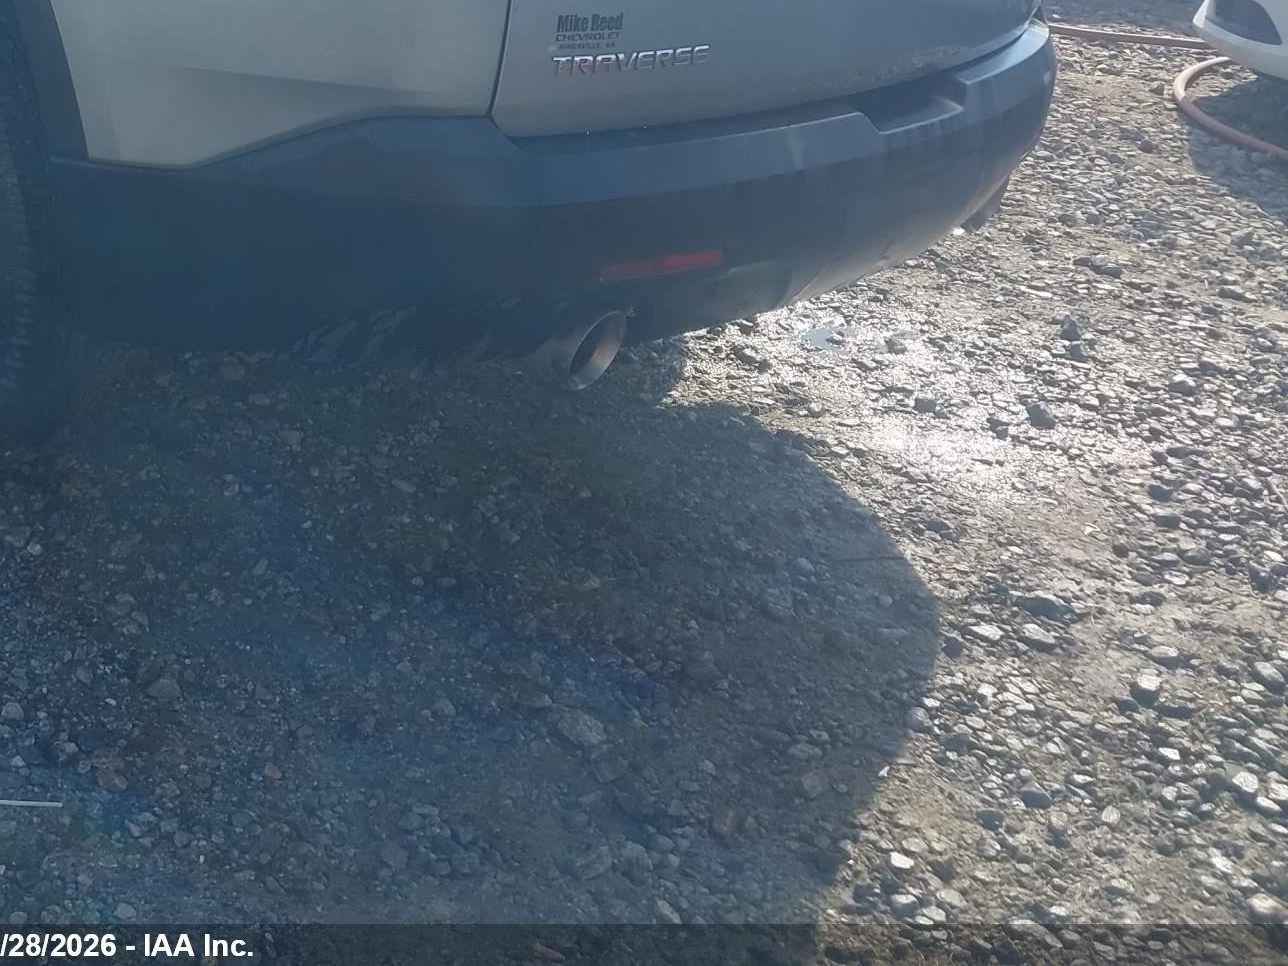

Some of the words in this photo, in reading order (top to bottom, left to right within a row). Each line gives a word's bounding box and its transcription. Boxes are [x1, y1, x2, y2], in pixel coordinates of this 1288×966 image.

[557, 15, 589, 33] Mike
[591, 12, 623, 32] Reed
[556, 32, 620, 42] CHEVROLET
[552, 45, 711, 75] TRAVERSE
